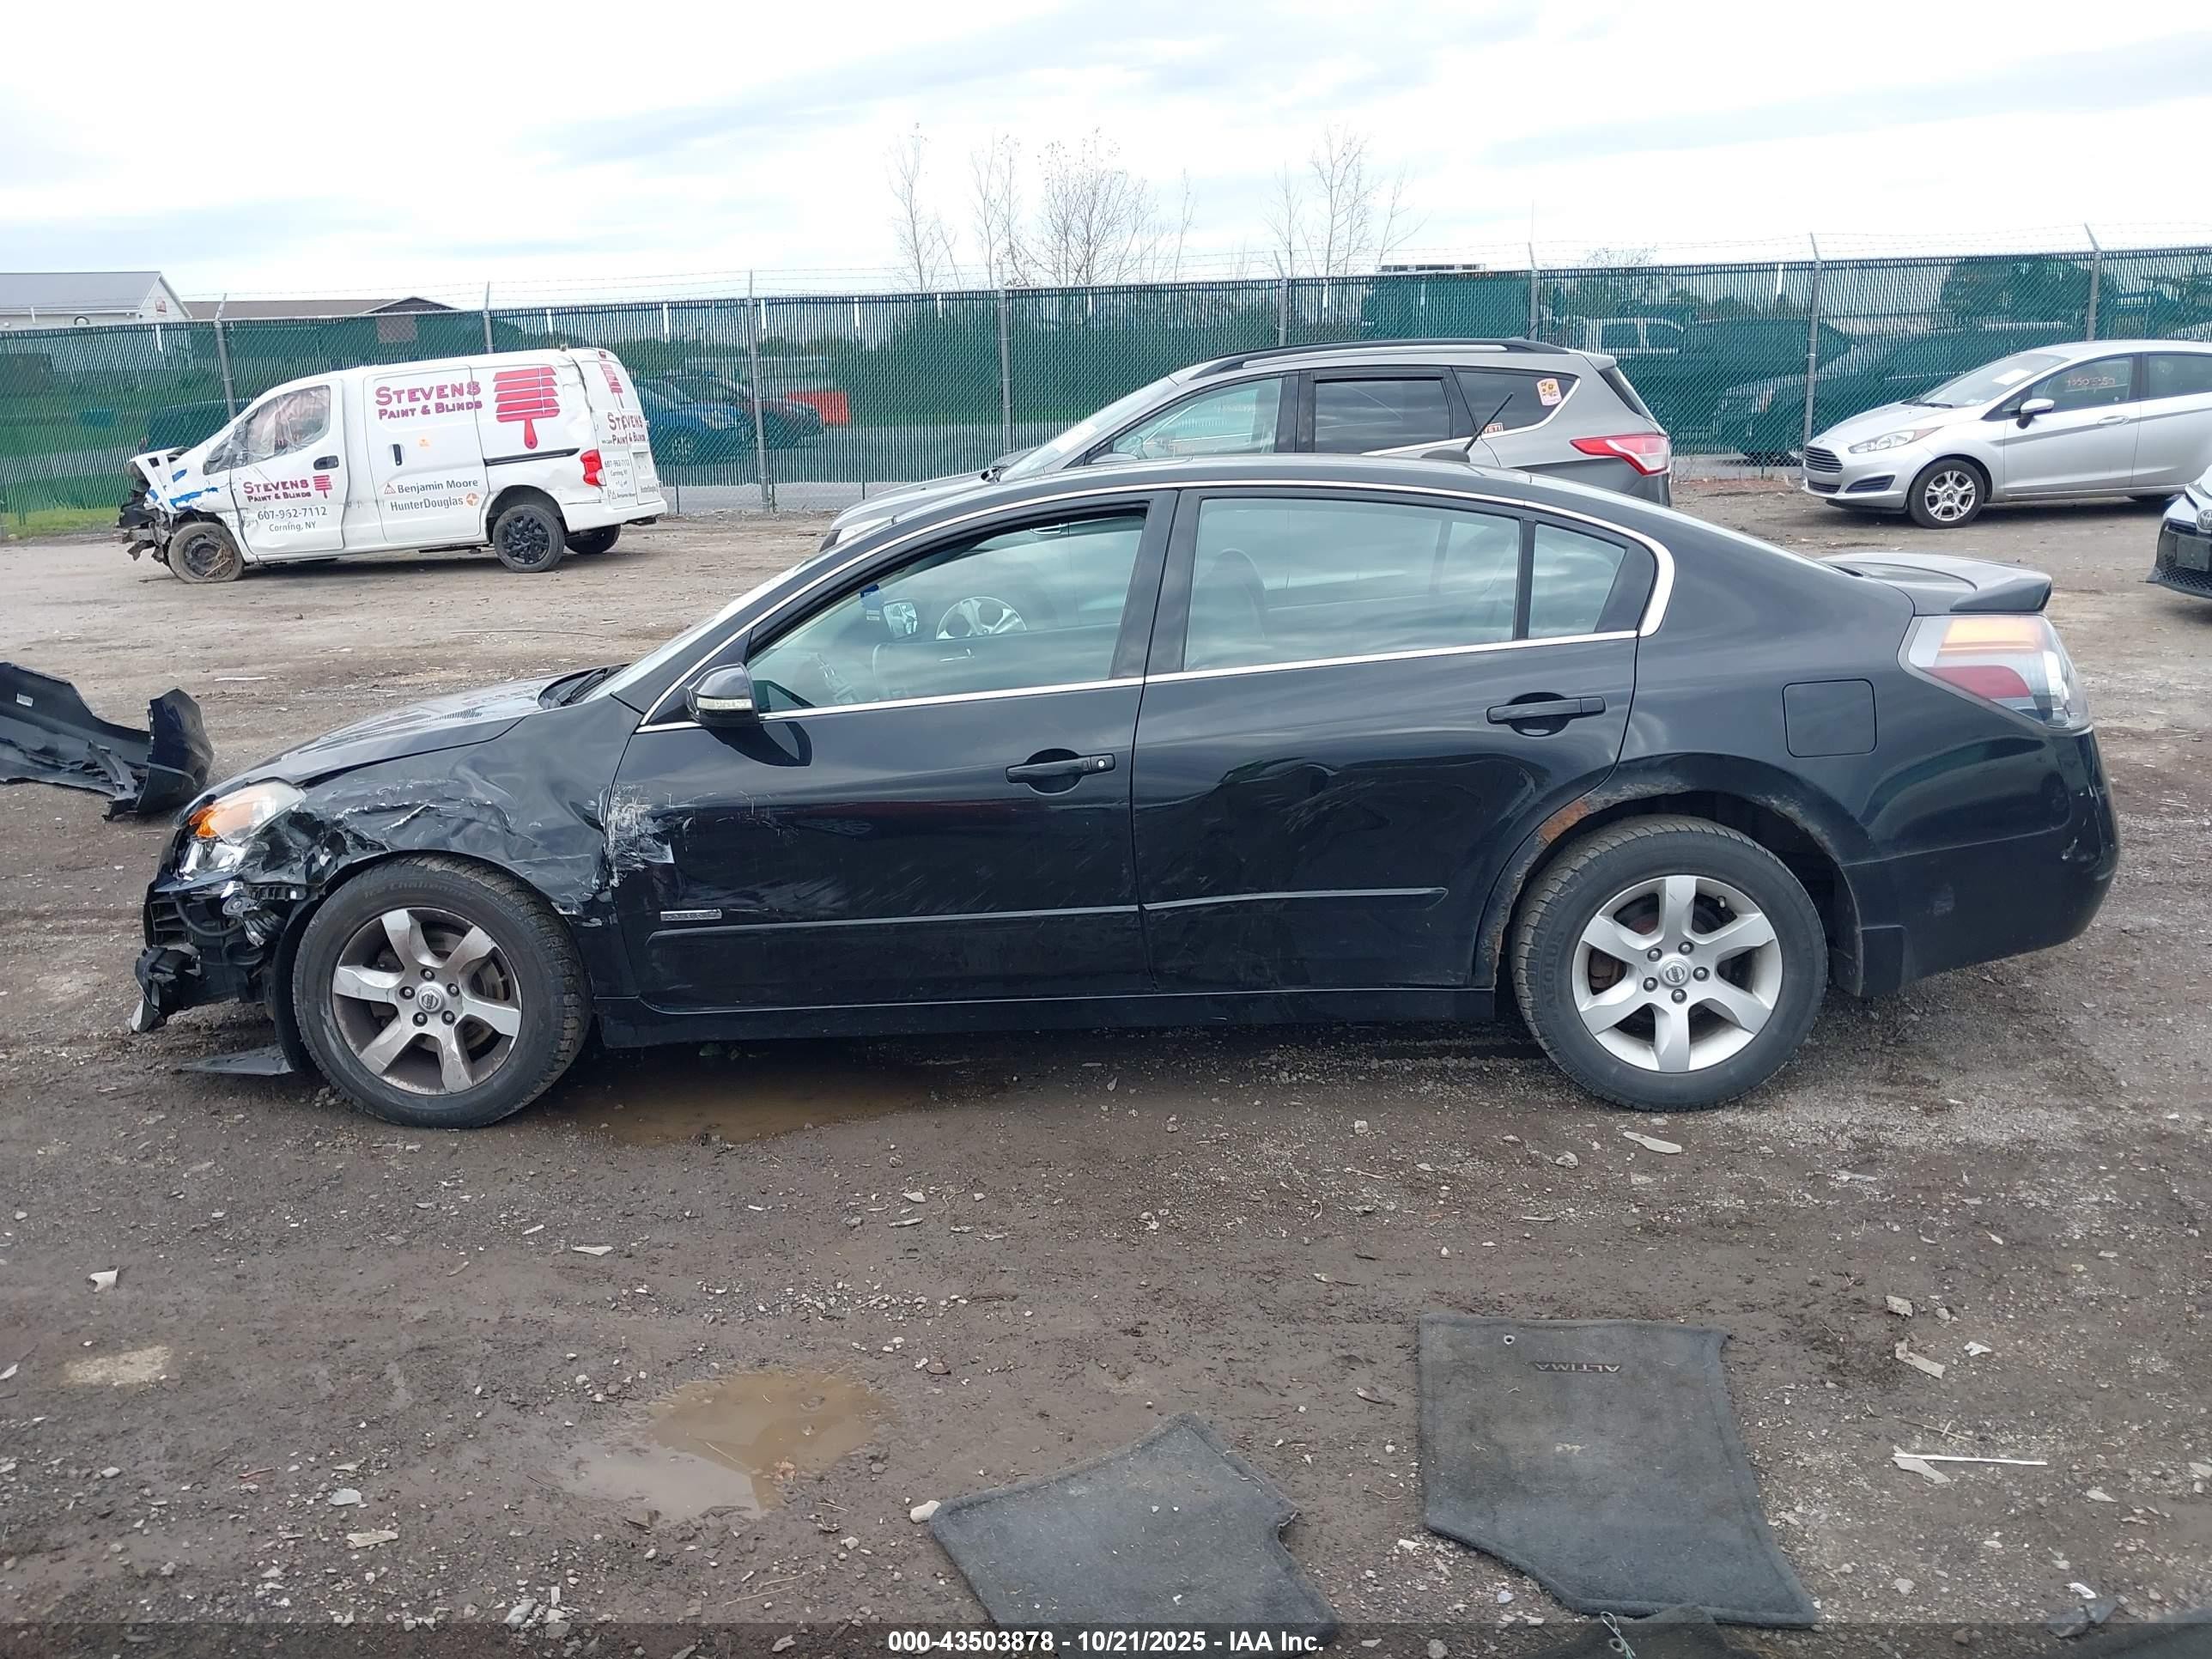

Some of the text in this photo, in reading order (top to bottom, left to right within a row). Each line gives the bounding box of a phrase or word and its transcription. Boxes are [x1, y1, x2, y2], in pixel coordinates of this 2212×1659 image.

[374, 380, 482, 406] STEVENS
[378, 400, 483, 421] PAINT & BLINDS
[243, 479, 310, 495] STEVENS
[397, 477, 479, 495] Benjamin Moore
[246, 495, 272, 503] PAINT
[390, 495, 465, 512] HunterDouglas
[305, 520, 317, 530] NY
[1534, 1362, 1620, 1372] ALTIMA
